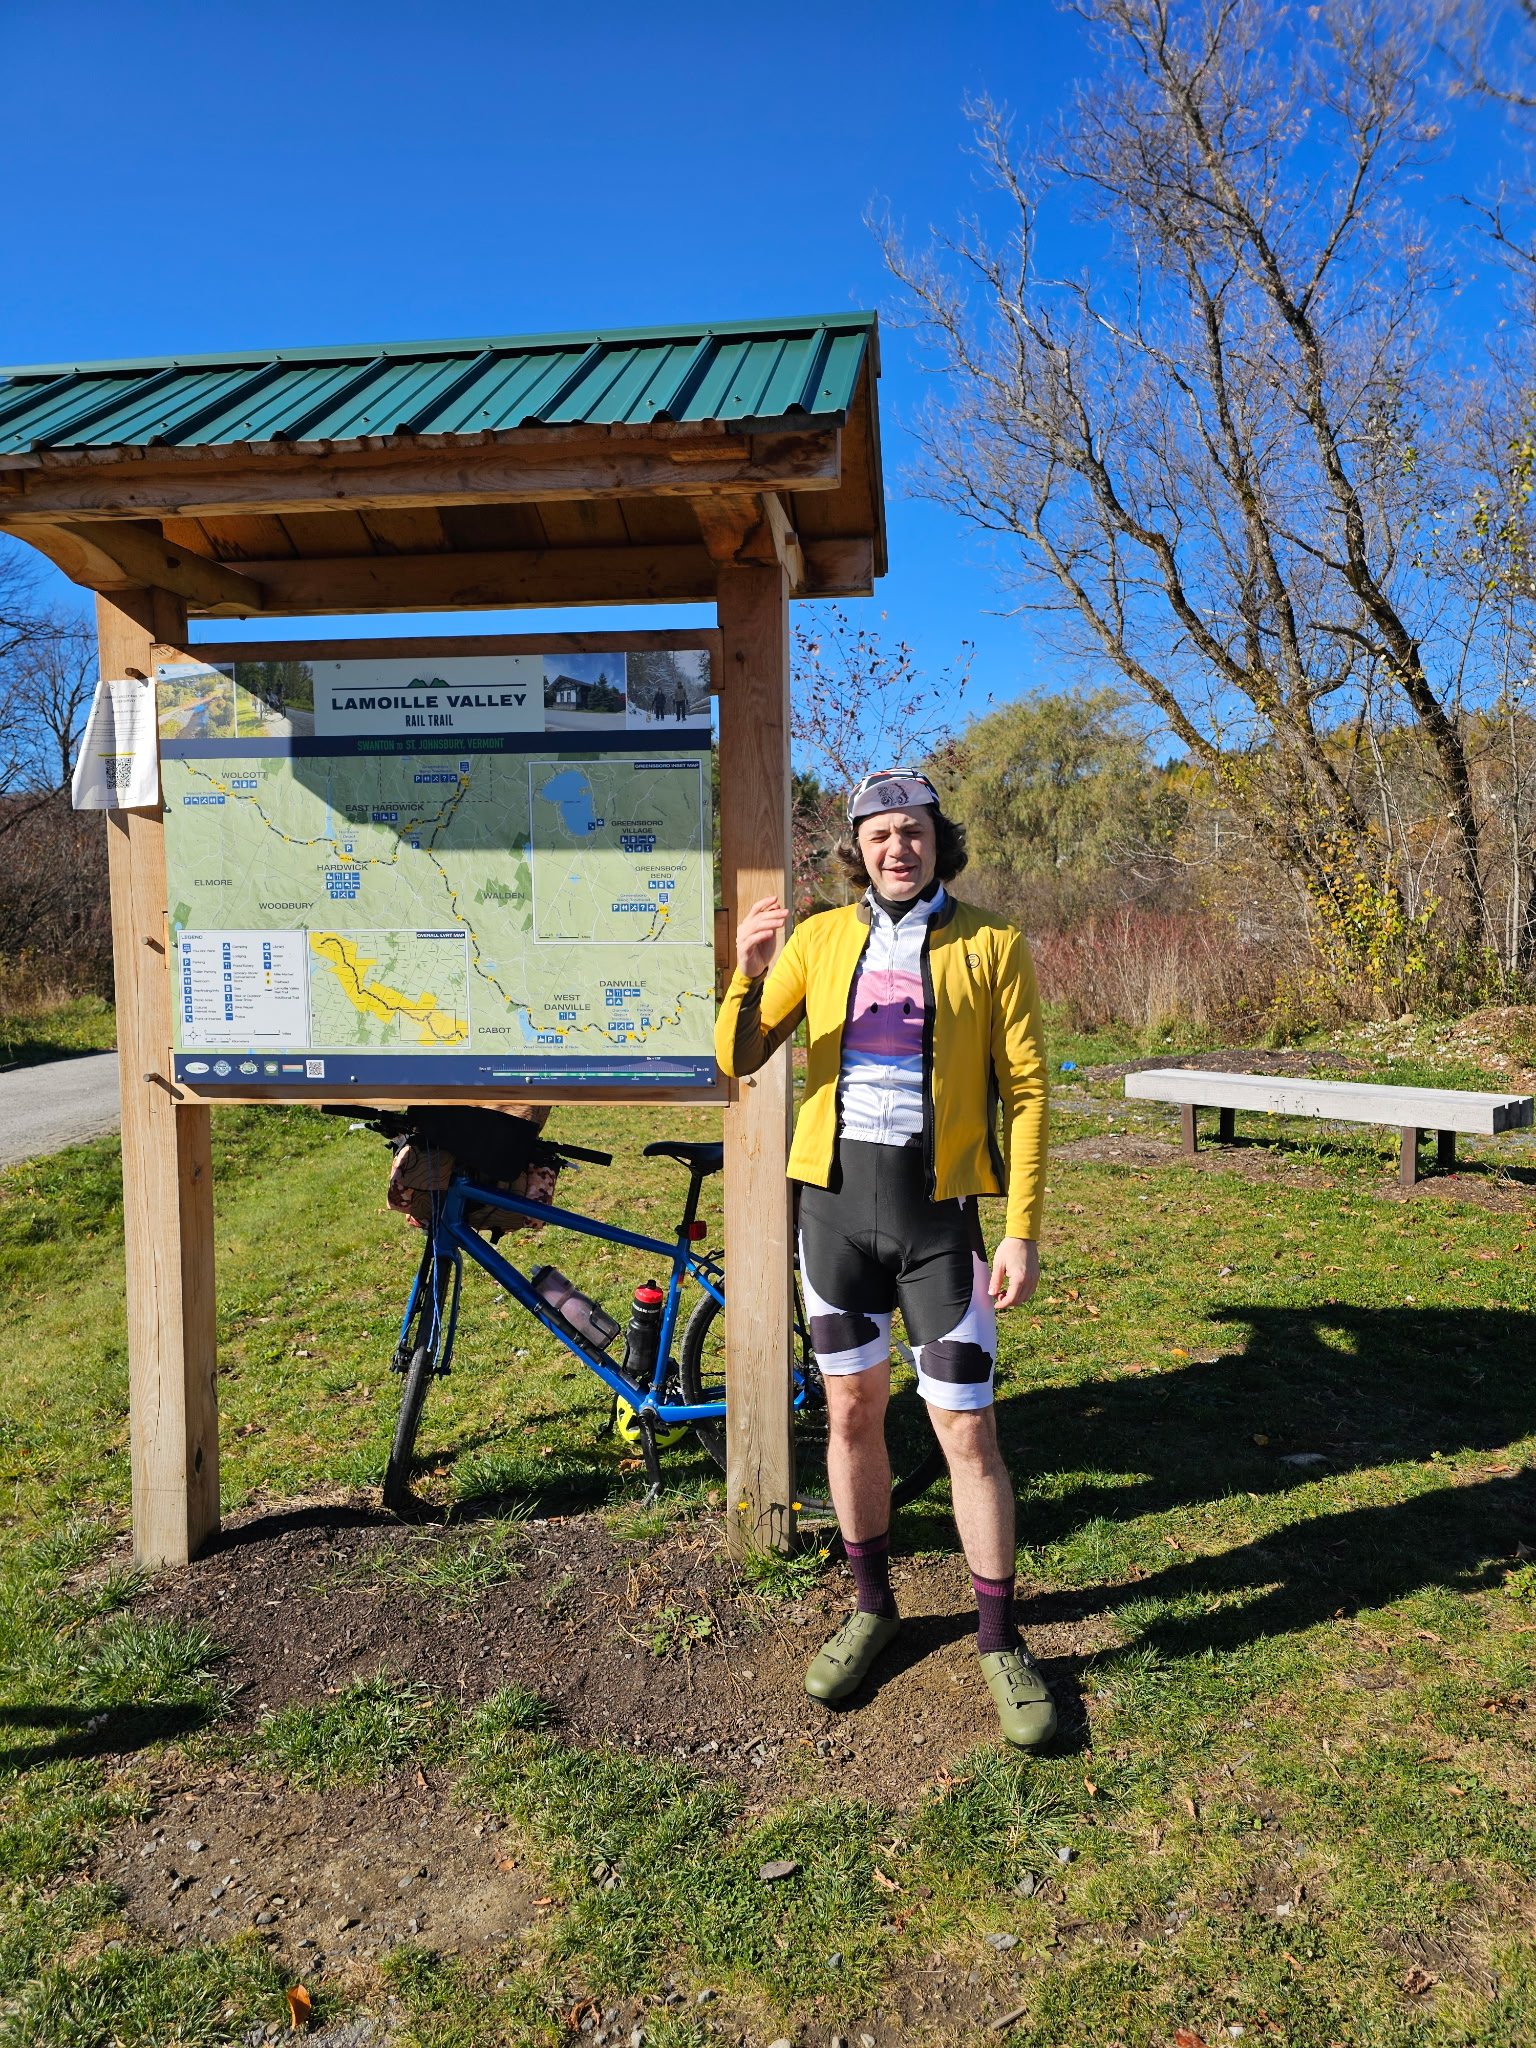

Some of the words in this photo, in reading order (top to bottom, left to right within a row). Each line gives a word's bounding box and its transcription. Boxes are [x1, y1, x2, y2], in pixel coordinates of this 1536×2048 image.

[331, 695, 439, 711] LAMOILLE
[446, 693, 527, 708] VALLEY
[405, 714, 425, 727] RAIL
[428, 714, 454, 726] TRAIL
[357, 739, 395, 751] SWANTON
[405, 739, 417, 750] ST.
[418, 738, 466, 750] JOHNSBURY,
[467, 737, 505, 749] VERMONT
[221, 771, 268, 779] WOLCOTT
[345, 804, 369, 812] EAST
[372, 803, 425, 812] HARDWICK
[316, 863, 369, 872] HARDWICK
[194, 879, 233, 887] ELMORE
[483, 891, 525, 900] WALDEN
[258, 902, 314, 910] WOODBURY
[599, 980, 647, 988] DANVILLE
[544, 1003, 591, 1011] DANVILLE
